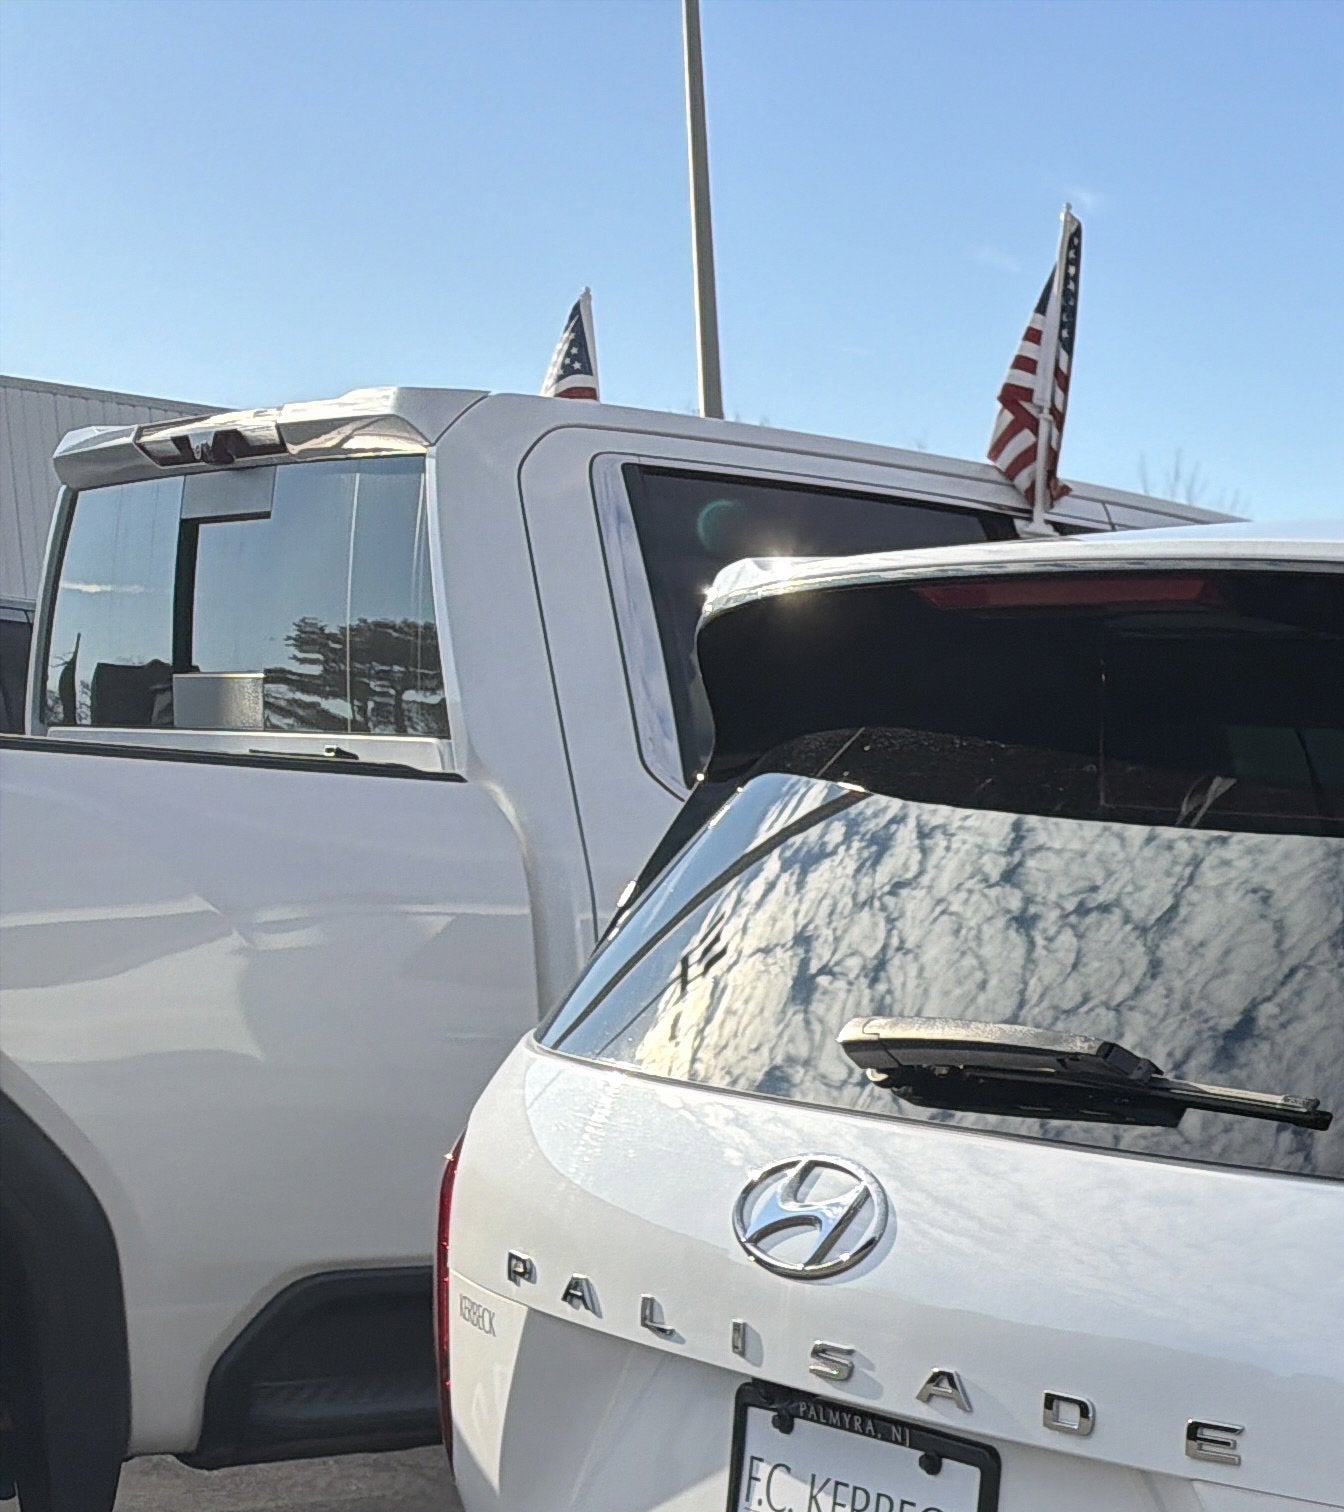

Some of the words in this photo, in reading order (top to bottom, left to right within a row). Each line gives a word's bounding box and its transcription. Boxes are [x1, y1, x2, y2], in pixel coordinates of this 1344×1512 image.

[507, 1249, 1244, 1466] PALISADE
[799, 1401, 882, 1439] PALMYRA,
[892, 1425, 910, 1448] NJ
